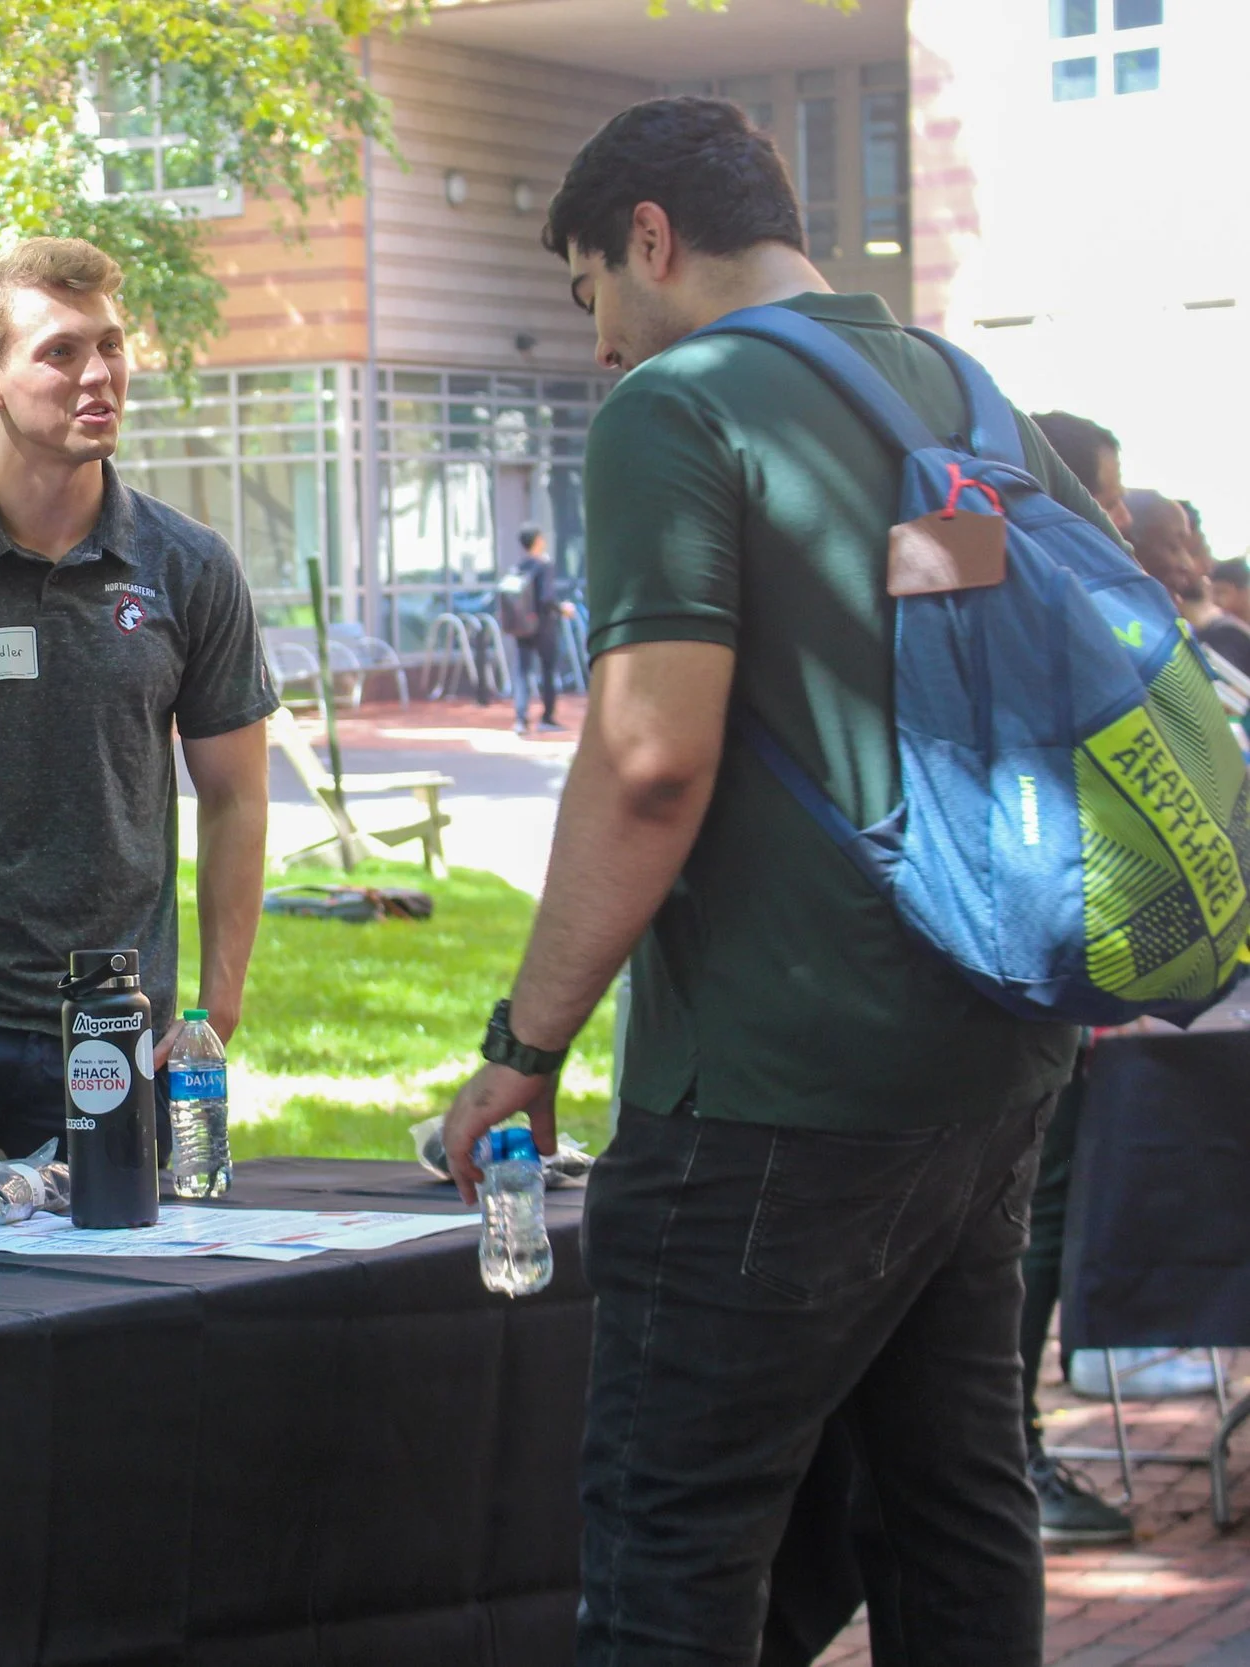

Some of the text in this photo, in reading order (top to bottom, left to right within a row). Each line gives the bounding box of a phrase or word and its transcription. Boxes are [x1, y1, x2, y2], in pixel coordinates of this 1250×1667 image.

[104, 582, 155, 598] NORTHEASTERN
[1133, 729, 1240, 900] READY FOR
[1110, 747, 1227, 918] ANYTHING
[74, 1015, 139, 1034] Algorand
[73, 1067, 120, 1080] #HACK
[71, 1079, 125, 1091] BOSTON
